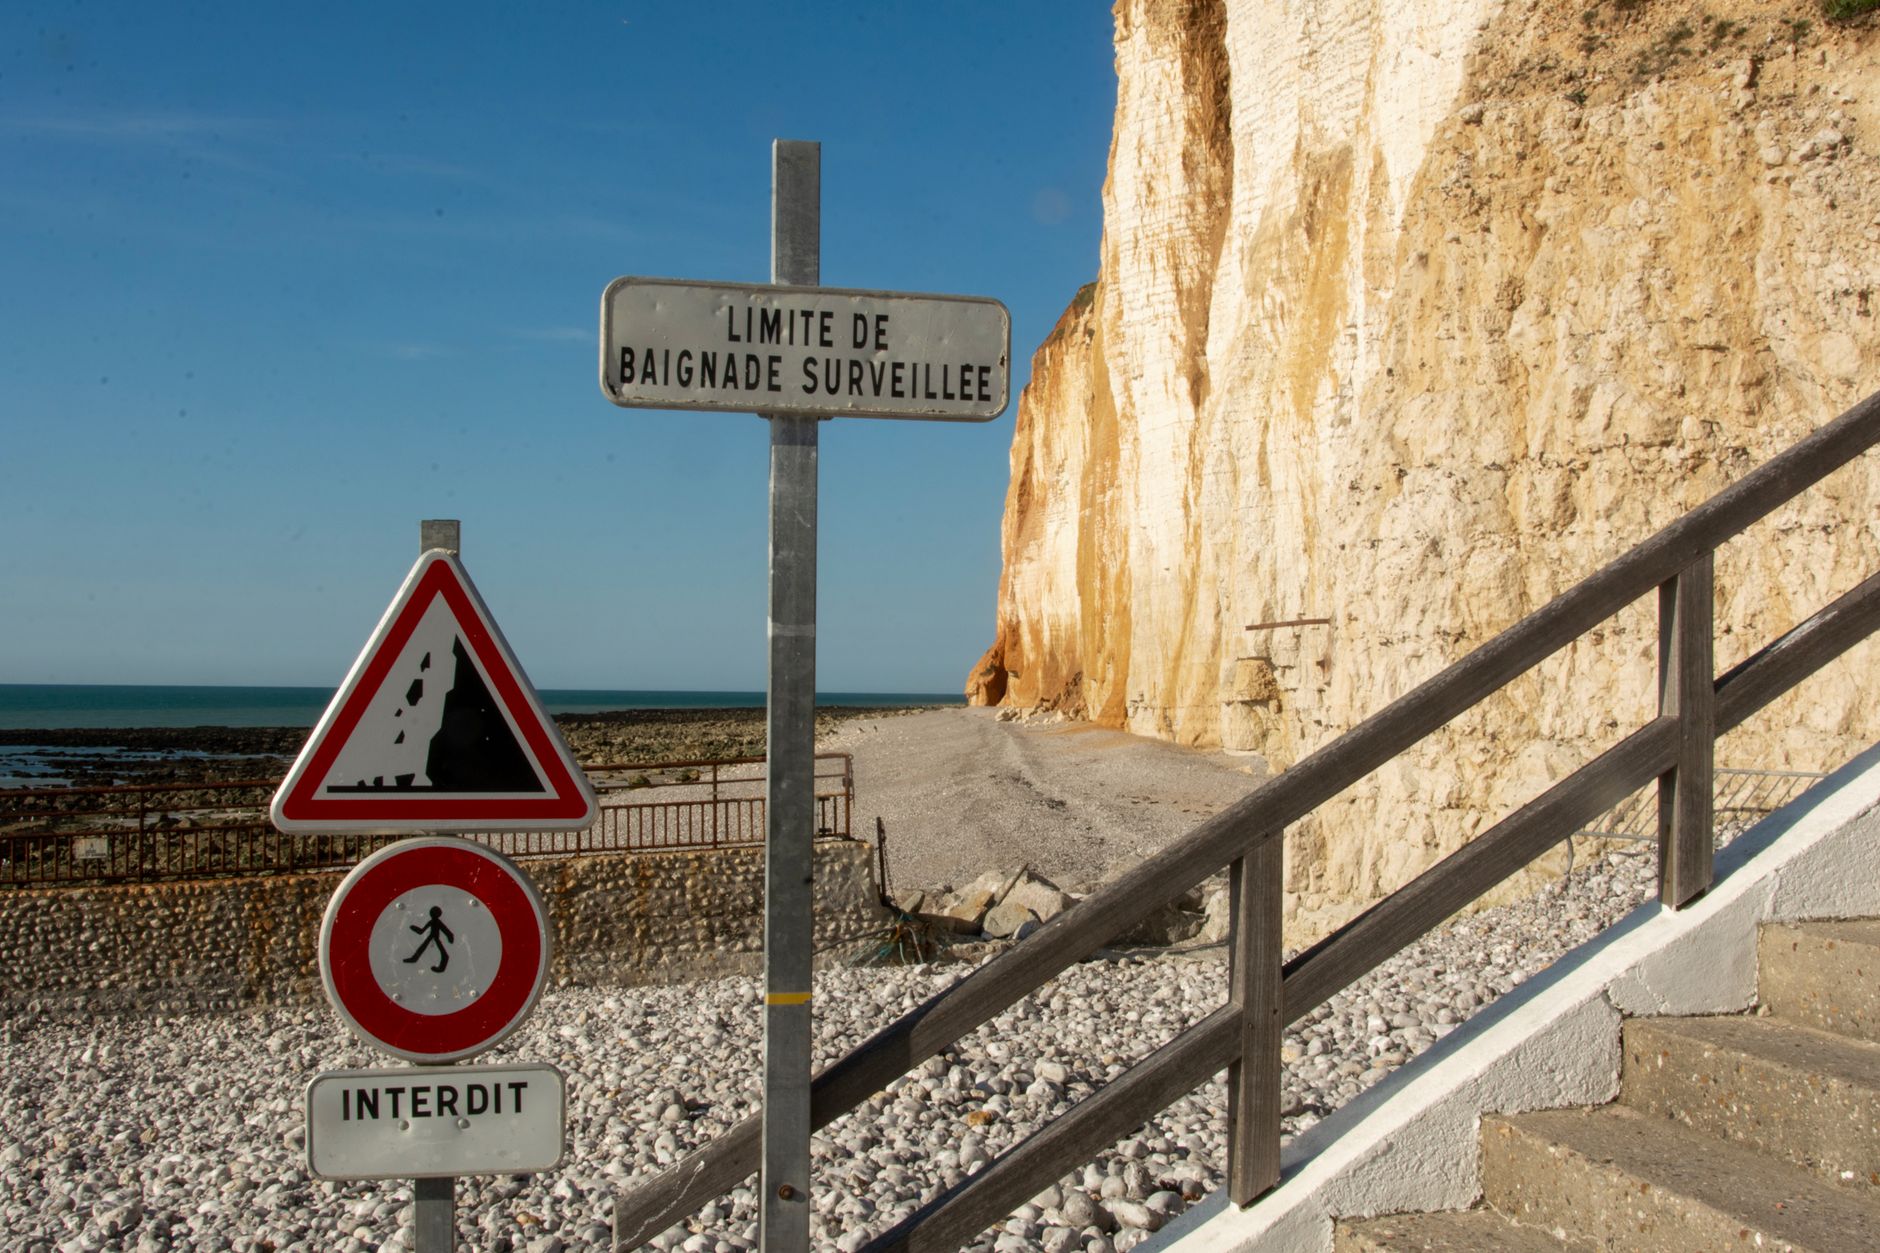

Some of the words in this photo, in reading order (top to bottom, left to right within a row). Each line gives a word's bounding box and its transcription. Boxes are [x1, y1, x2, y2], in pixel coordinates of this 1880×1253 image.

[728, 305, 833, 347] LIMITE
[853, 313, 889, 350] DE
[619, 347, 782, 392] BAIGNADE
[342, 1082, 528, 1121] INTERDIT
